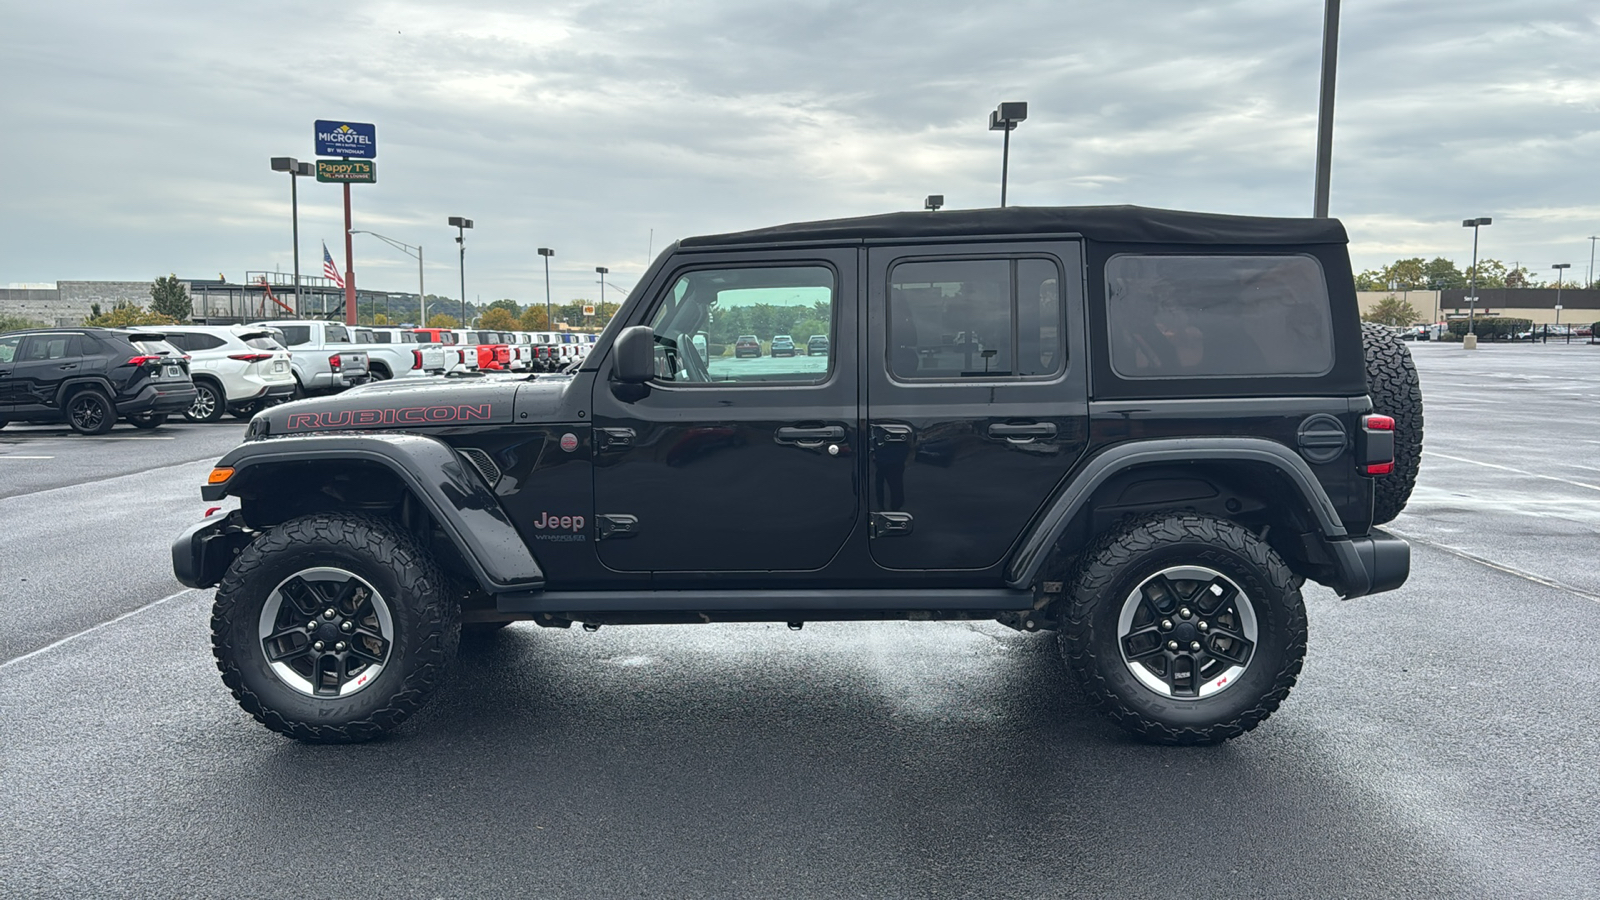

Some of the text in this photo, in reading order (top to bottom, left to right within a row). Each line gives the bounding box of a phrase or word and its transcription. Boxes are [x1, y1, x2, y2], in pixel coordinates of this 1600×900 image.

[318, 132, 372, 144] MICROTEL
[319, 162, 370, 173] Pappy T's
[287, 404, 492, 429] RUBICON
[533, 511, 585, 533] Jeep
